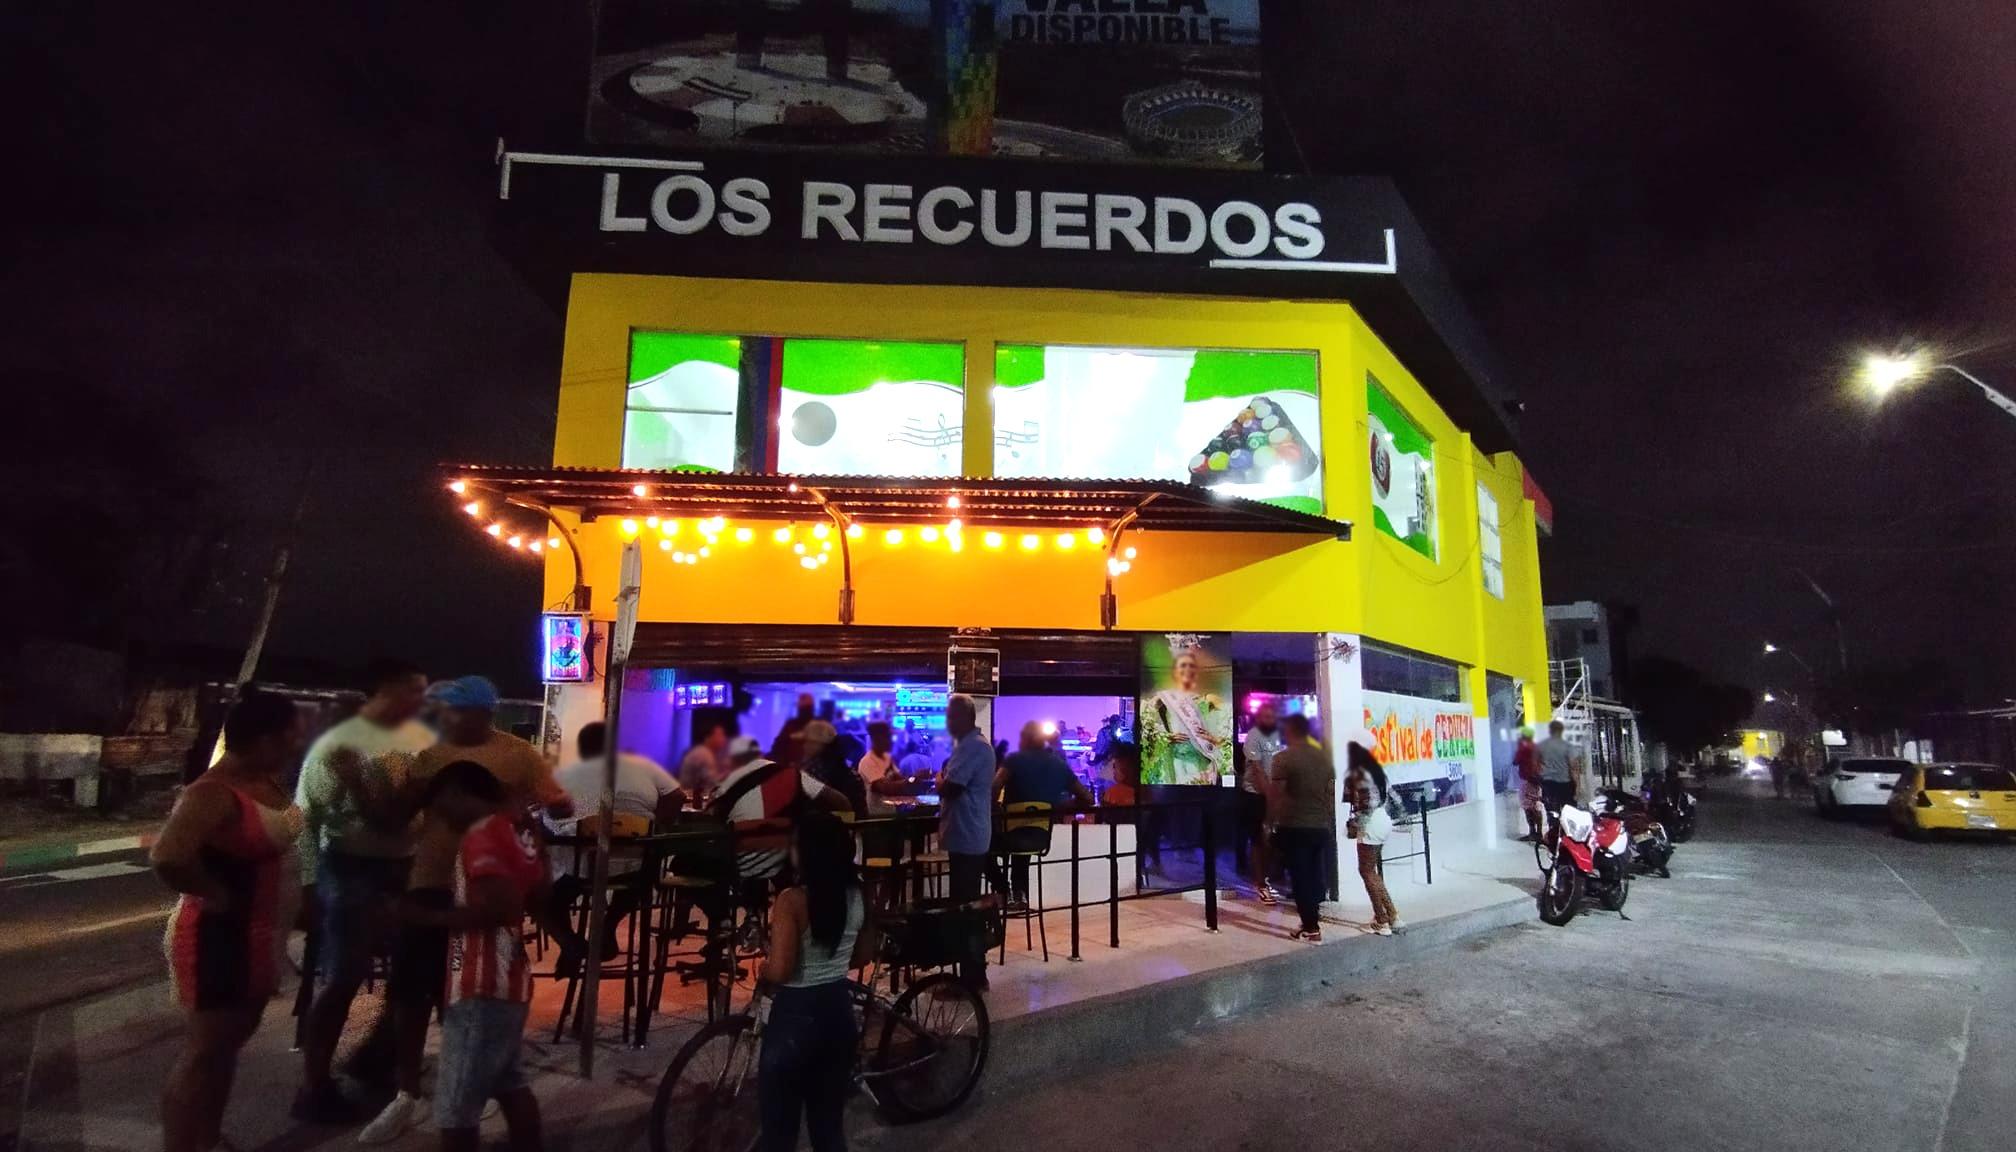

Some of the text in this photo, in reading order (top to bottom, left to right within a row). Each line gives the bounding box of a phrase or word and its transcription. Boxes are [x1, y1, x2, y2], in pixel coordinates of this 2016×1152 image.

[1010, 14, 1231, 44] DISPONIBLE
[600, 173, 1325, 259] LOS RECUERDOS
